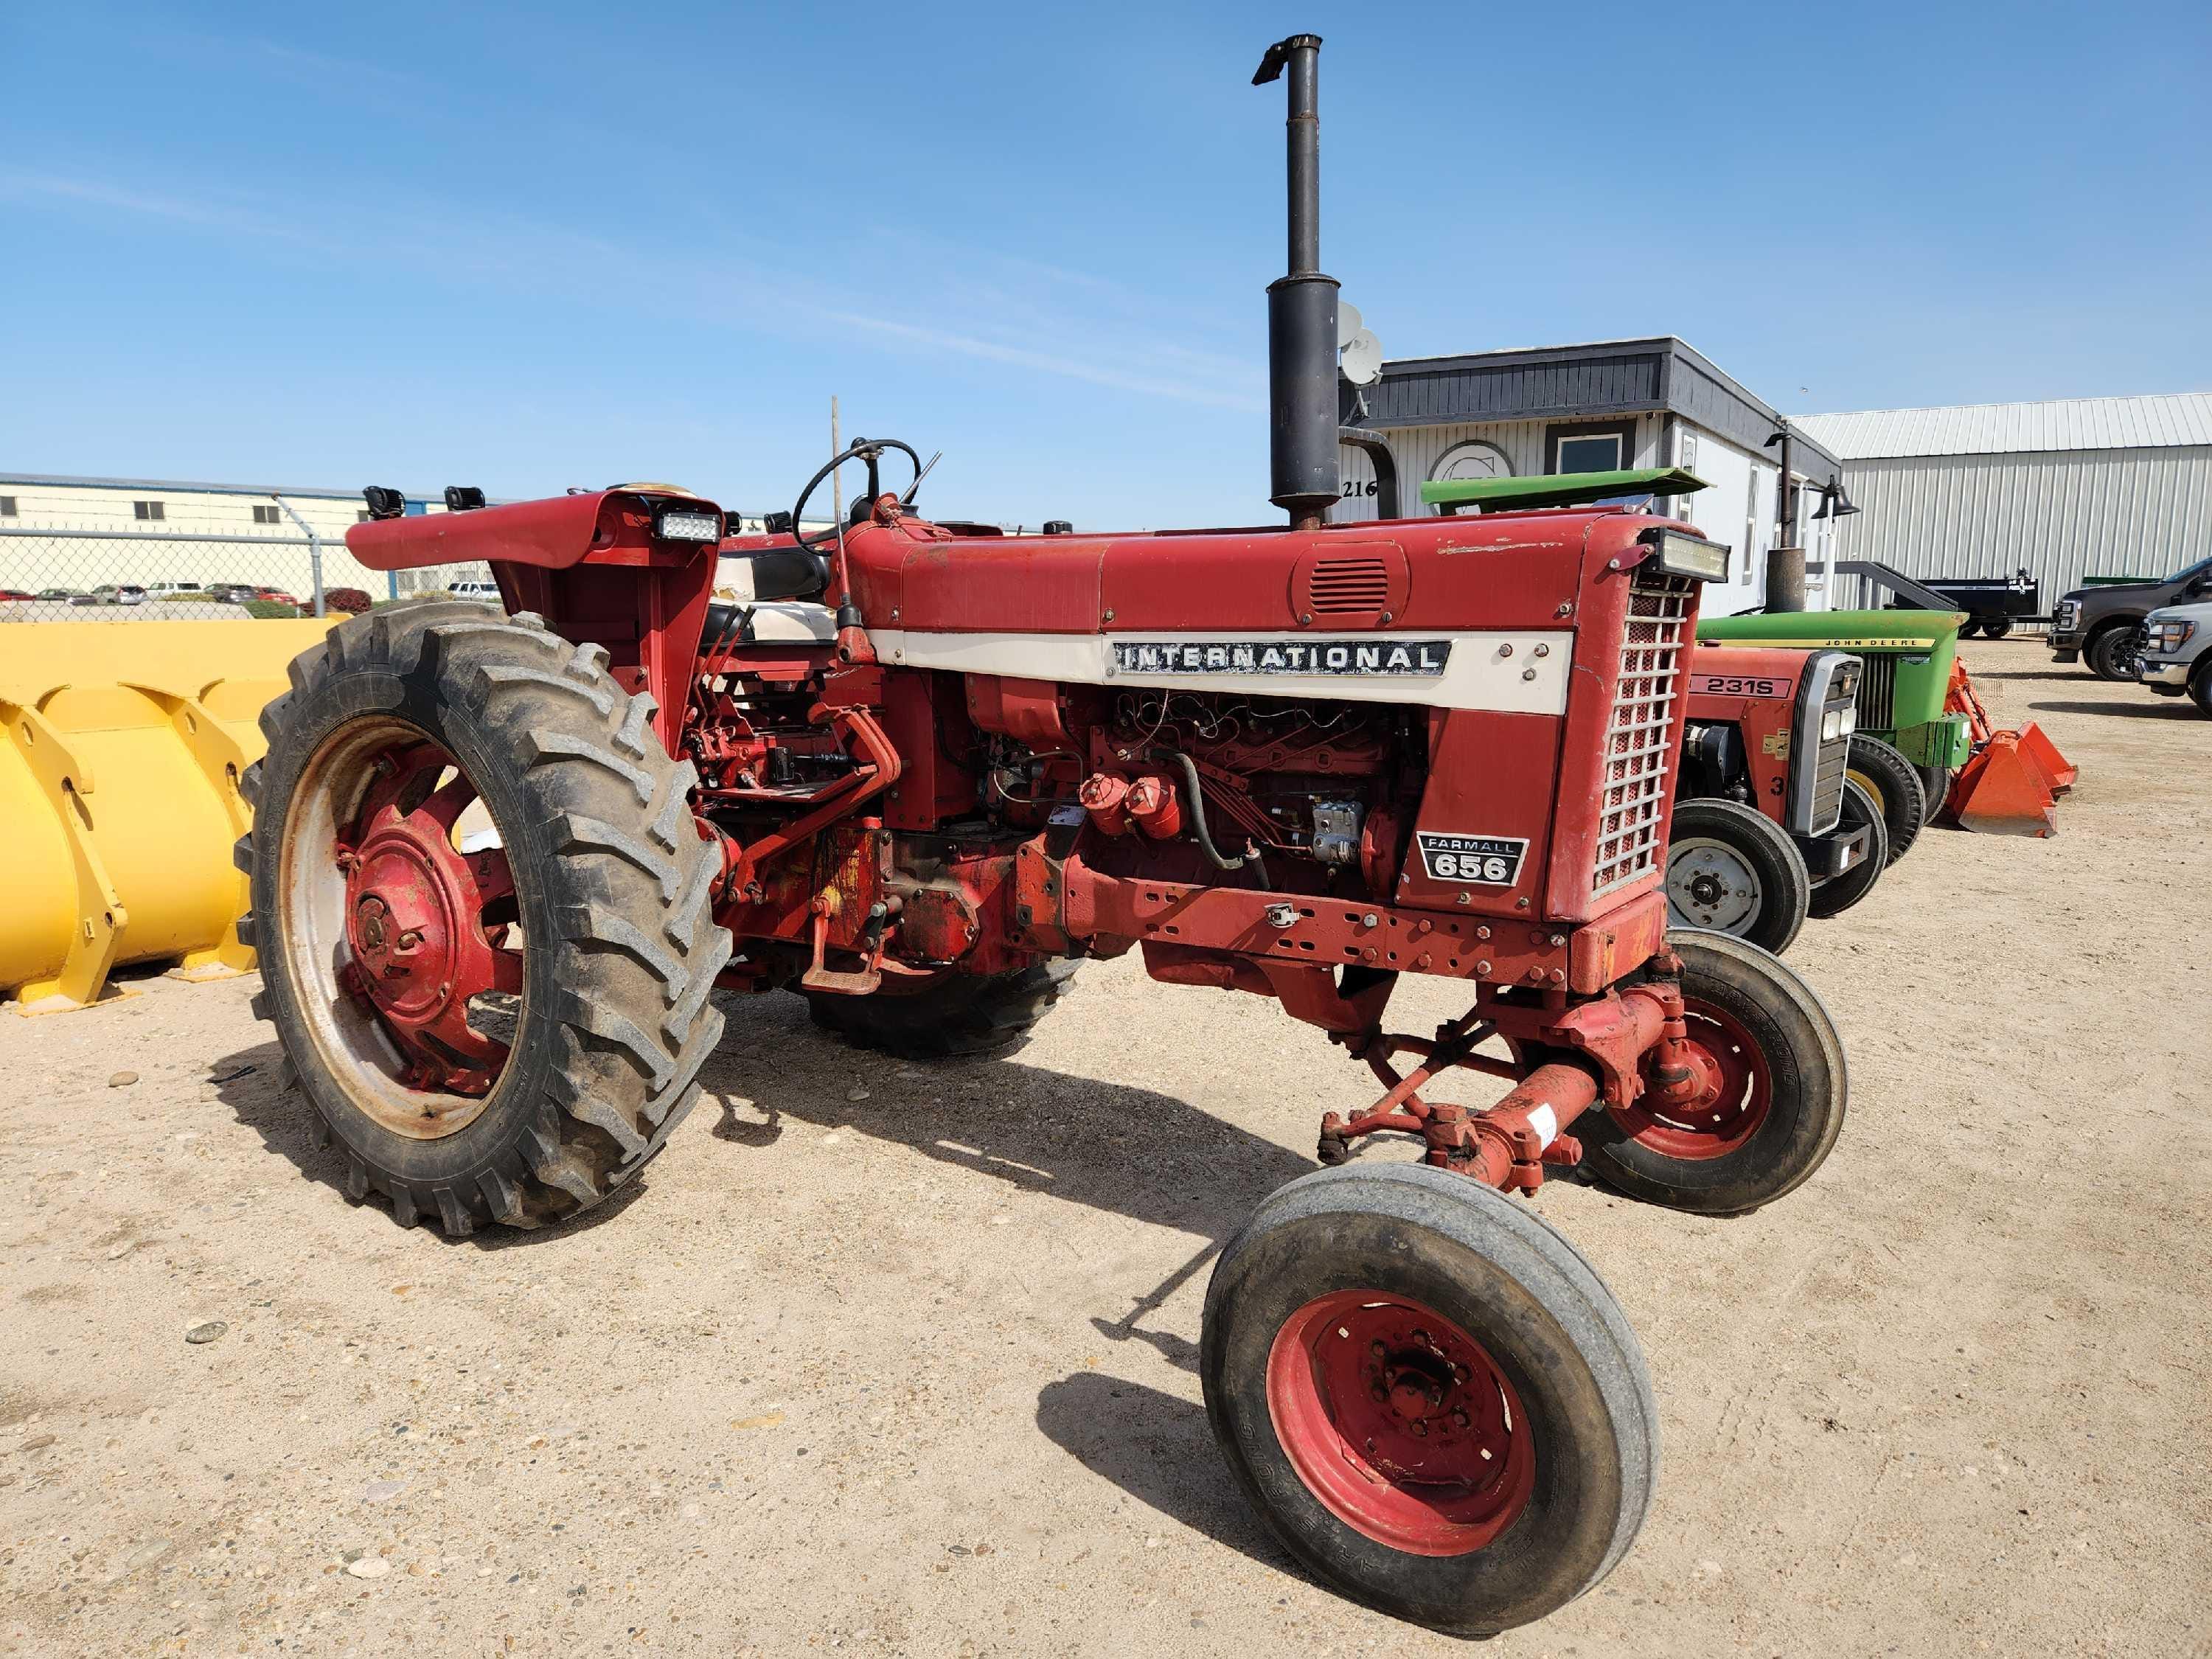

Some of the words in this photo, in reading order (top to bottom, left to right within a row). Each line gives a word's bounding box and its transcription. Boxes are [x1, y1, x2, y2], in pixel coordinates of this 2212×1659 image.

[1125, 646, 1441, 668] INTERNATIONAL
[1707, 678, 1773, 695] 231S
[1770, 776, 1784, 796] 3
[1428, 838, 1514, 853] FARMALL
[1435, 854, 1507, 880] 656
[1239, 1422, 1380, 1576] ARMSTRONG
